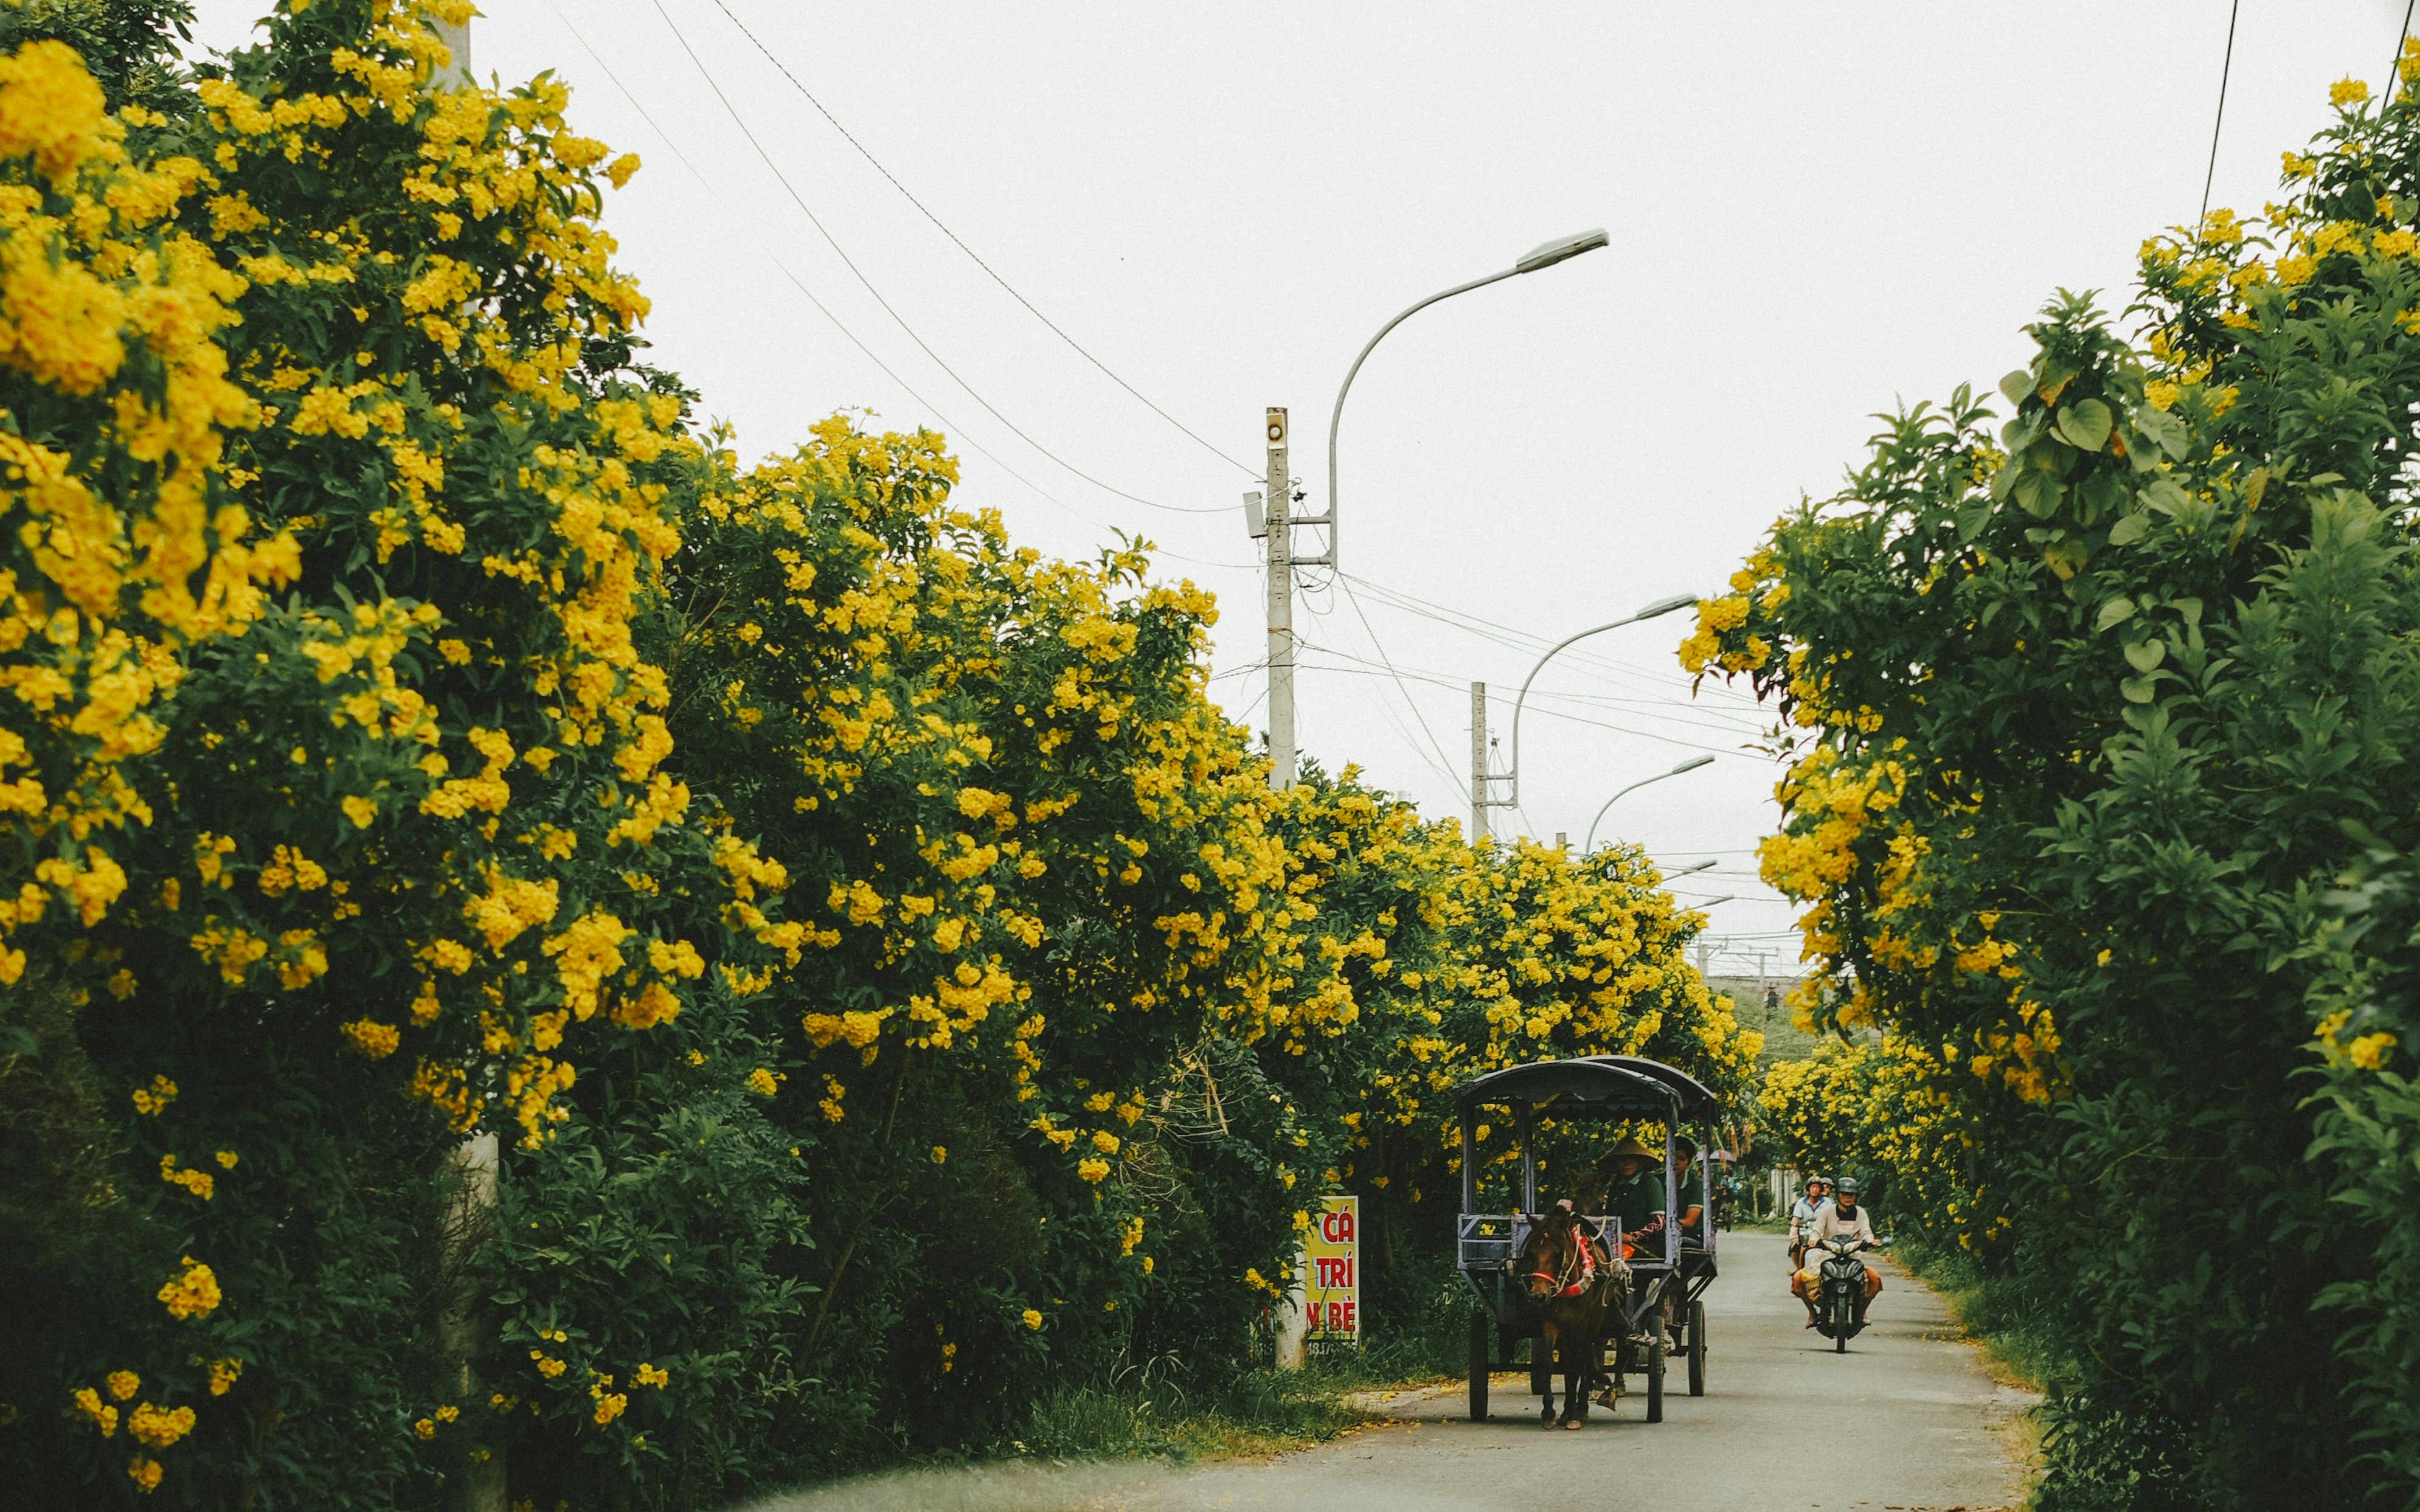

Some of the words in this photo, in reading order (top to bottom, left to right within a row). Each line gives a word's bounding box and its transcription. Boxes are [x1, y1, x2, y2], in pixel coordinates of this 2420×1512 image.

[1322, 1205, 1354, 1243] CÁ
[1315, 1250, 1353, 1288] TRÍ
[1328, 1294, 1356, 1332] BÈ
